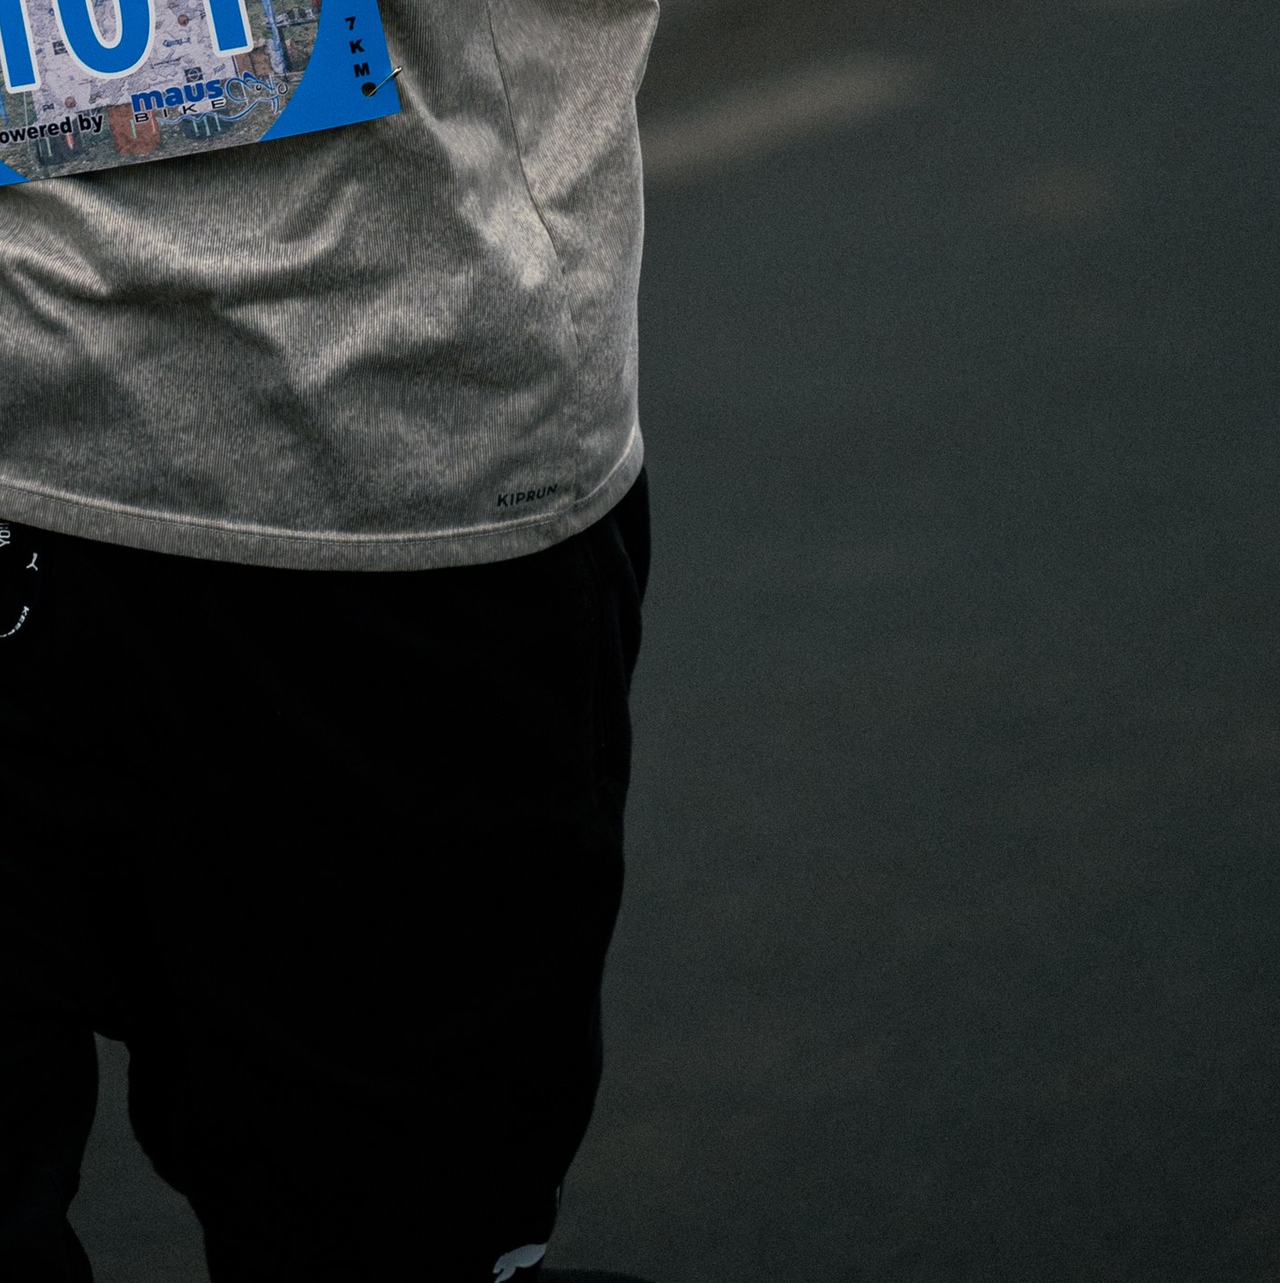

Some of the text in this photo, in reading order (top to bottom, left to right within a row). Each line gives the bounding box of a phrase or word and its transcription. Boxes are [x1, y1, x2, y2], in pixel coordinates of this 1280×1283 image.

[131, 78, 225, 113] maus
[134, 98, 226, 124] BIKE
[79, 113, 105, 134] by
[497, 484, 558, 507] KIPRUN
